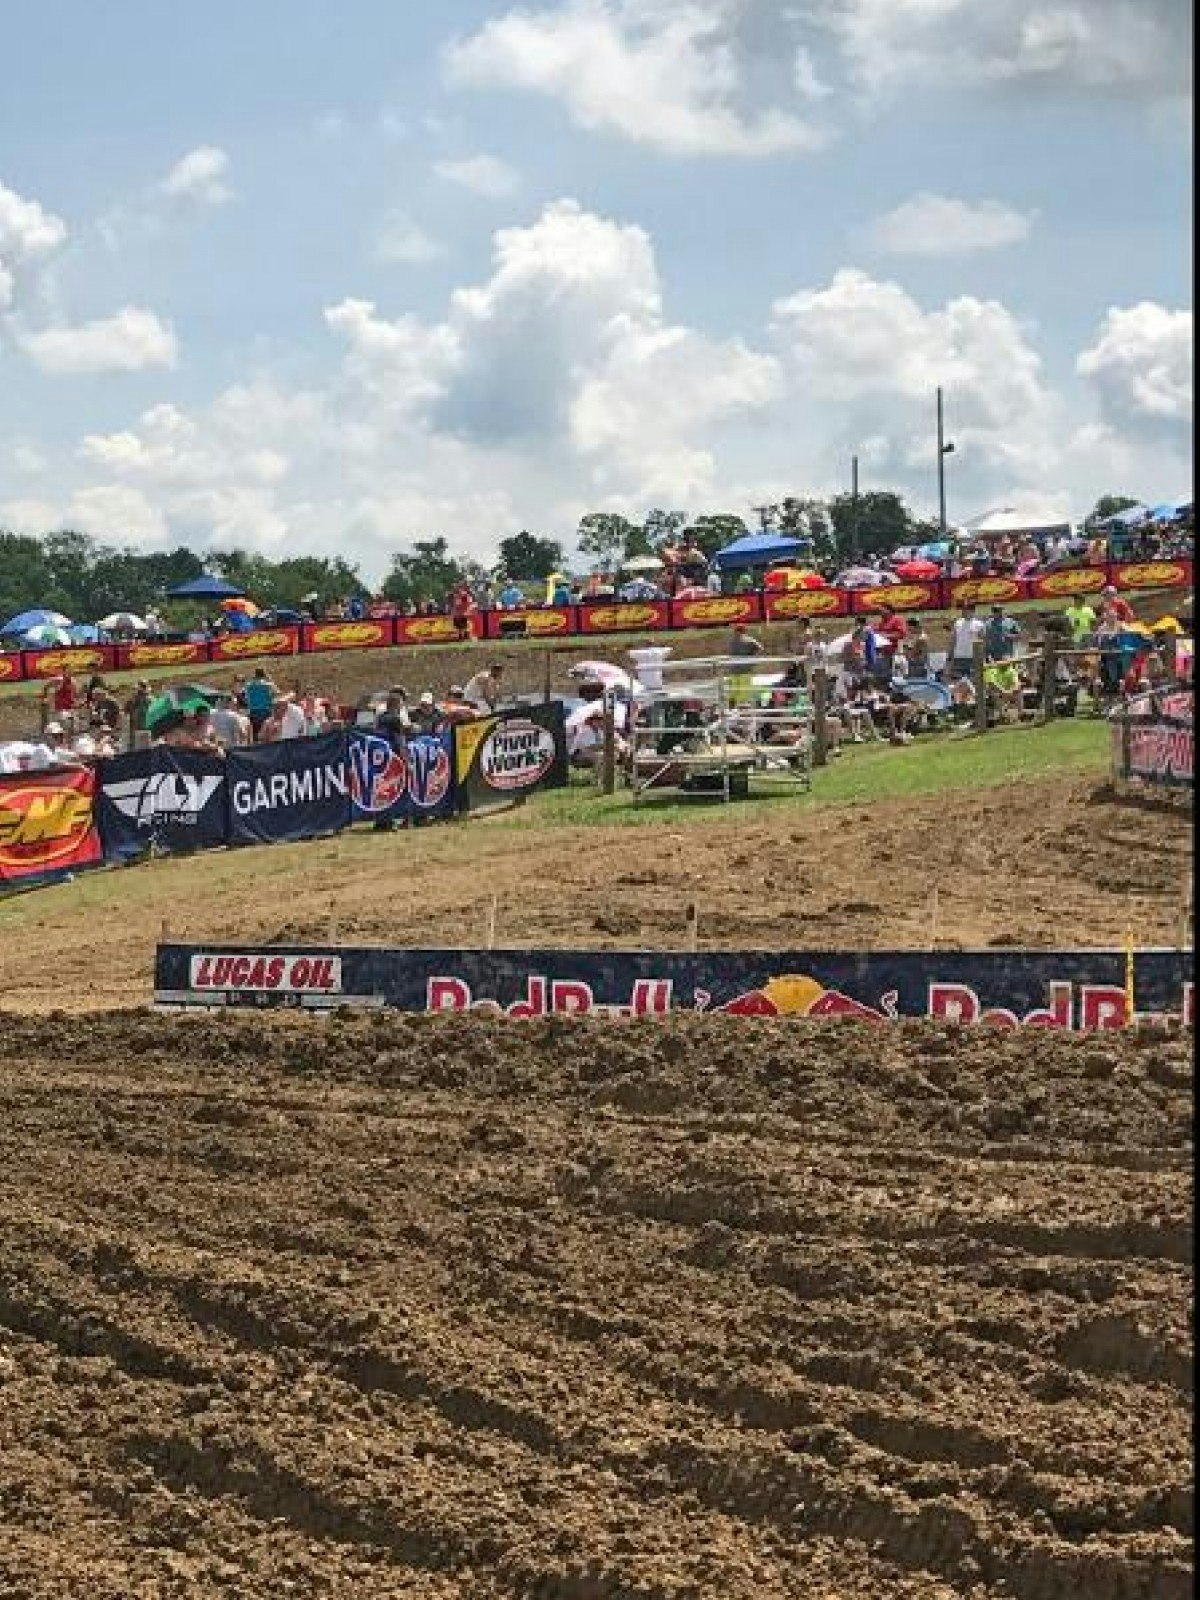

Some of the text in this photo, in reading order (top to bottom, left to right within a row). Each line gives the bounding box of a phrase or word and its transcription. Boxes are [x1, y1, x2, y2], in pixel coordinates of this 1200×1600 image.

[492, 731, 540, 755] Pivot
[487, 749, 548, 774] Works
[103, 773, 224, 817] FLY
[233, 762, 348, 814] GARMIN
[196, 957, 334, 988] LUCAS OIL
[552, 979, 673, 1017] Bll
